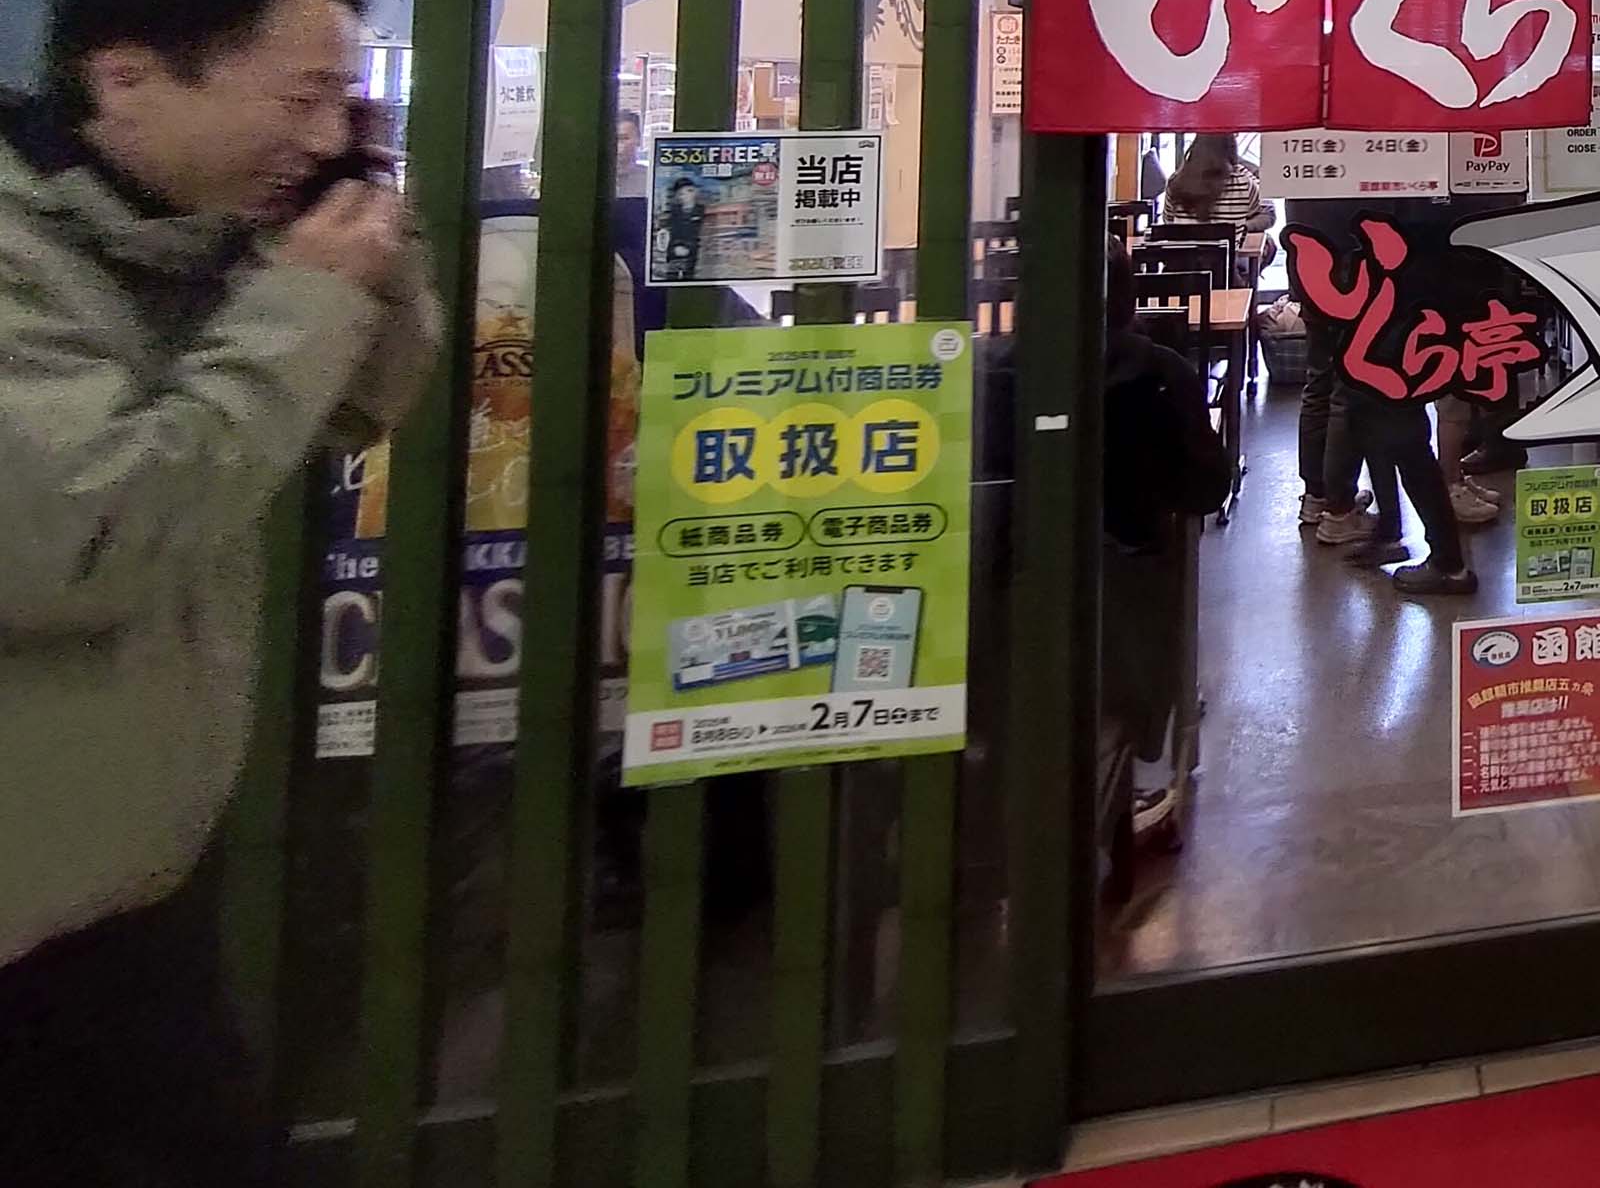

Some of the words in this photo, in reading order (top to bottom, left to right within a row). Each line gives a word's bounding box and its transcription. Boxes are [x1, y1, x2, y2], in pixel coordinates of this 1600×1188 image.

[1567, 128, 1597, 137] ORDER
[797, 154, 863, 185] 当店
[1466, 160, 1511, 173] PayPay
[794, 188, 861, 209] 掲載中
[1289, 219, 1541, 402] いくら亭
[672, 363, 944, 401] プレミアム付商品券
[693, 420, 920, 485] 取扱店
[1530, 496, 1593, 517] 取扱店
[679, 522, 784, 549] 紙商品券
[821, 513, 933, 539] 電子商品券
[687, 552, 919, 587] 当店でご利用できます
